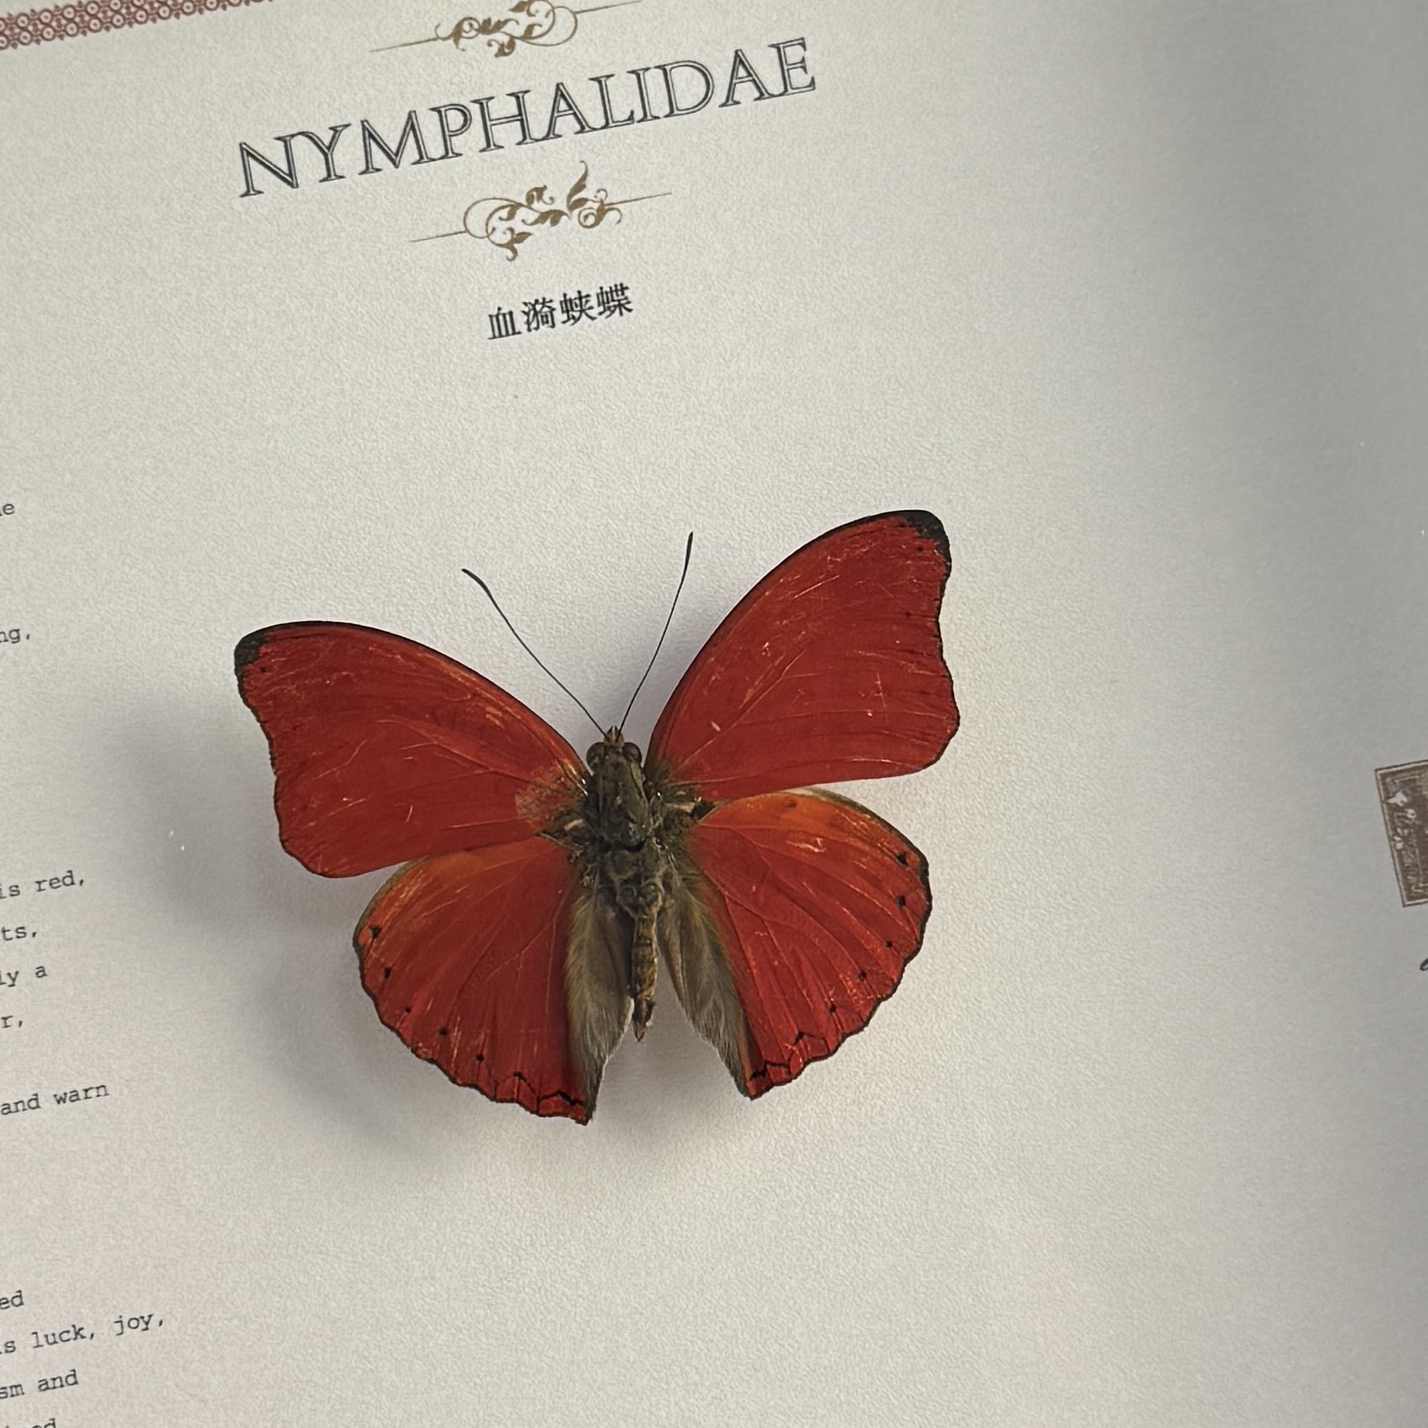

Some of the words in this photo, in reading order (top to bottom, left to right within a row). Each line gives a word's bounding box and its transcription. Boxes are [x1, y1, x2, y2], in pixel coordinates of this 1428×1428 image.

[238, 37, 816, 198] NYMPHALIDAE
[487, 281, 634, 341] 血漪蛱蝶
[33, 869, 85, 893] red,
[34, 965, 49, 979] a
[0, 1092, 42, 1116] and
[52, 1084, 110, 1106] warn
[30, 1323, 95, 1349] luck,
[112, 1313, 164, 1337] joy,
[37, 1368, 80, 1393] and
